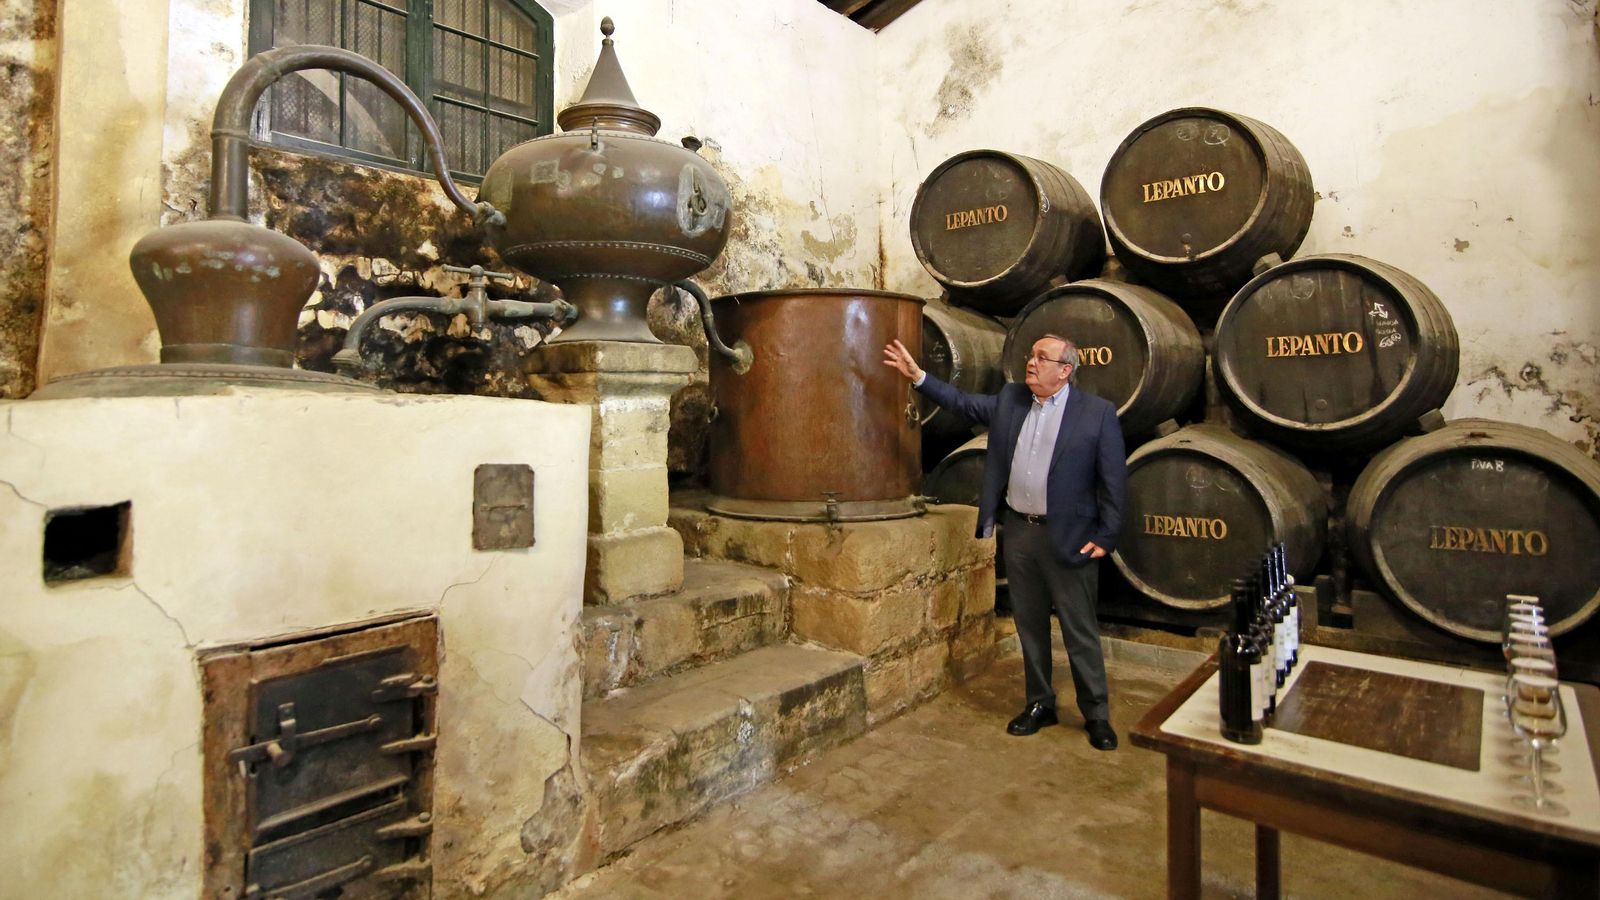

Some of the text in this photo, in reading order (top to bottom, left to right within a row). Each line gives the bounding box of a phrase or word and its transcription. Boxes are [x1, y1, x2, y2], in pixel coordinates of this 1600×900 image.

[1142, 171, 1225, 203] LEPANTO
[945, 204, 1008, 231] LEPANTO
[1265, 331, 1364, 358] LEPANTO
[1143, 514, 1228, 540] LEPANTO
[1428, 524, 1549, 556] LEPANTO
